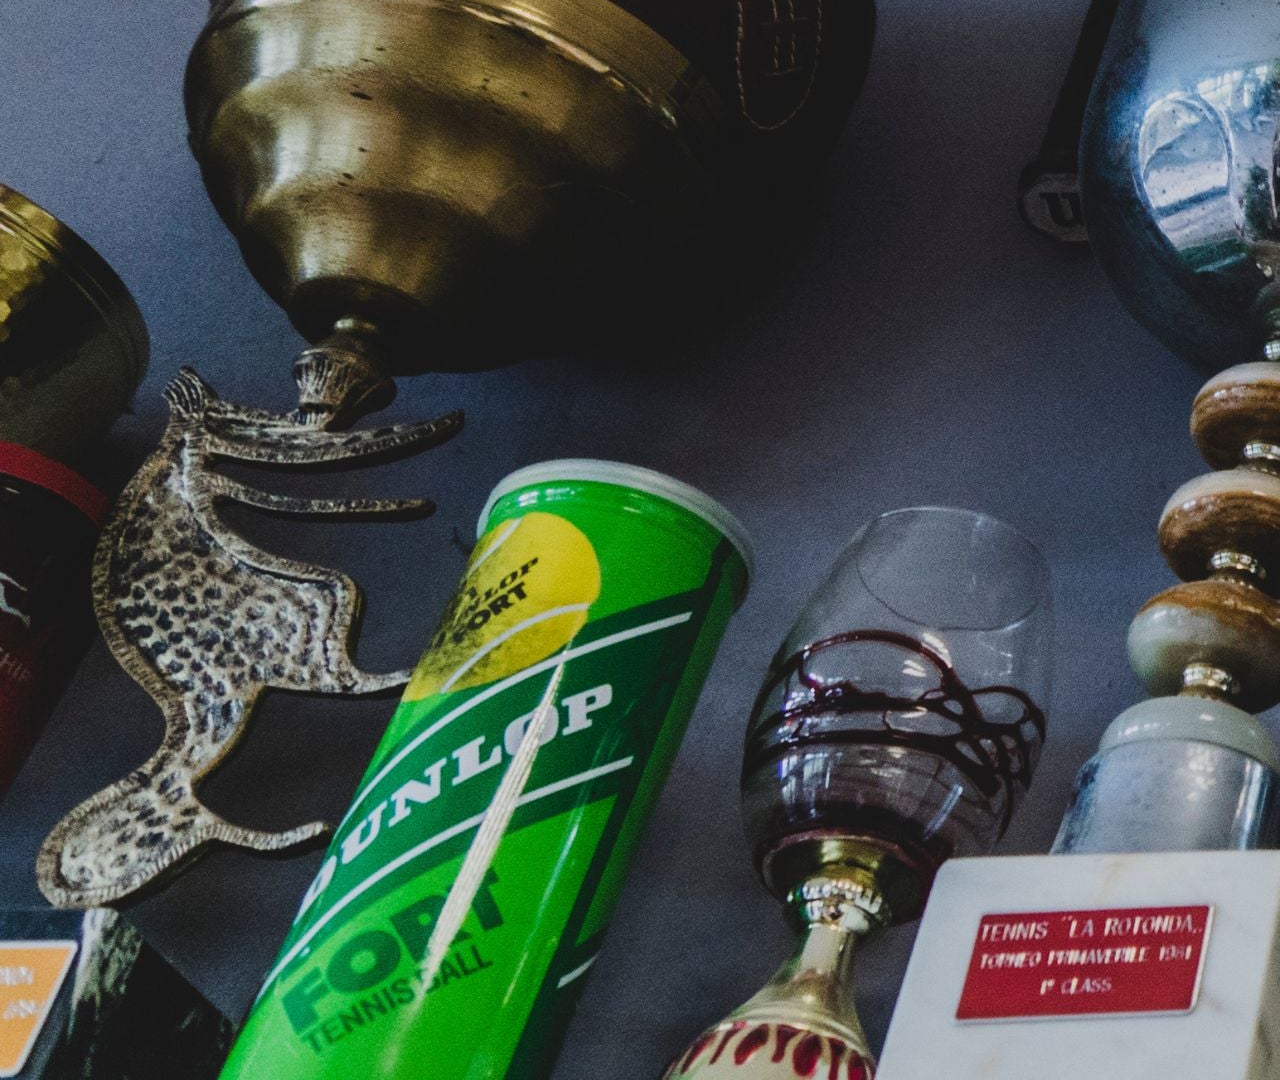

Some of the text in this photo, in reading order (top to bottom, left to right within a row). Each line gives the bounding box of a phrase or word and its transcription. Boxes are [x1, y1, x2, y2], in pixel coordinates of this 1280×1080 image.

[295, 683, 613, 921] DUNLOP
[281, 867, 504, 1037] FORT
[980, 951, 1041, 970] TORNEO
[981, 921, 1049, 942] TENNIS
[302, 977, 416, 1054] TENNIS
